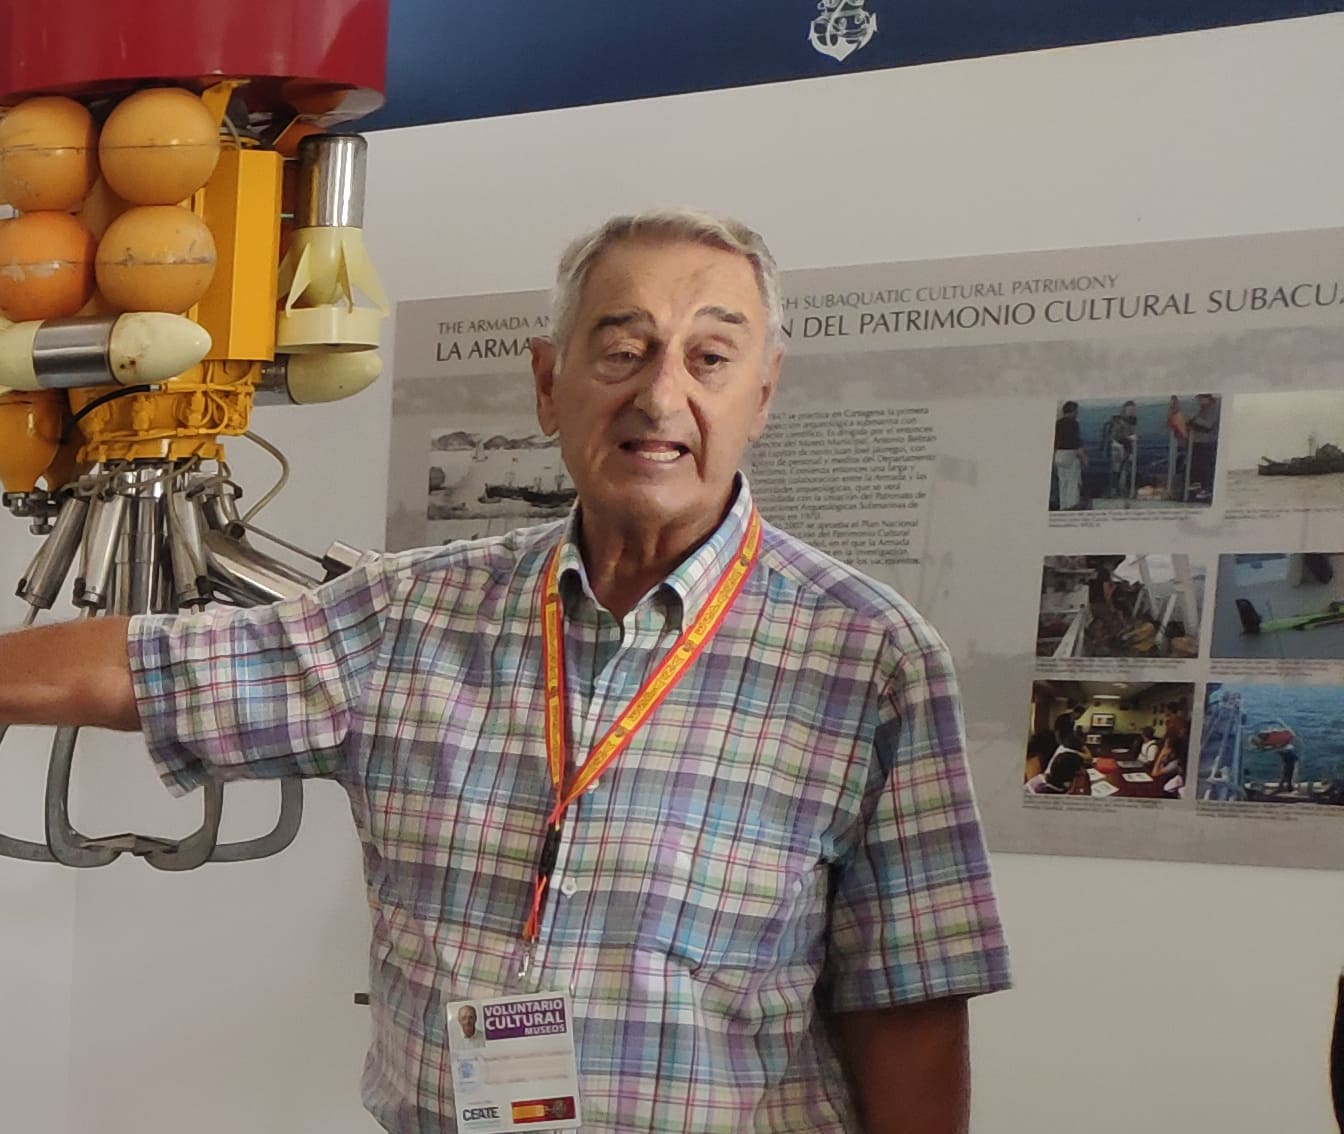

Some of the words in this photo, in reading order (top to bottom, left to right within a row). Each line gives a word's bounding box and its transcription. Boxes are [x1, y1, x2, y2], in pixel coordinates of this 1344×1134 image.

[438, 320, 463, 335] THE
[466, 315, 529, 334] ARMADA
[803, 288, 912, 310] SUBAQUATIC
[915, 281, 1006, 303] CULTURAL
[1011, 273, 1119, 296] PATRIMONY
[436, 341, 461, 361] LA
[467, 336, 533, 360] ARMA
[803, 315, 849, 338] DEL
[859, 302, 1036, 335] PATRIMONIO
[1044, 293, 1196, 324] CULTURAL
[485, 999, 563, 1017] VOLUNTARIO
[485, 1011, 565, 1031] CULTURAL
[524, 1023, 565, 1036] MUSEOS
